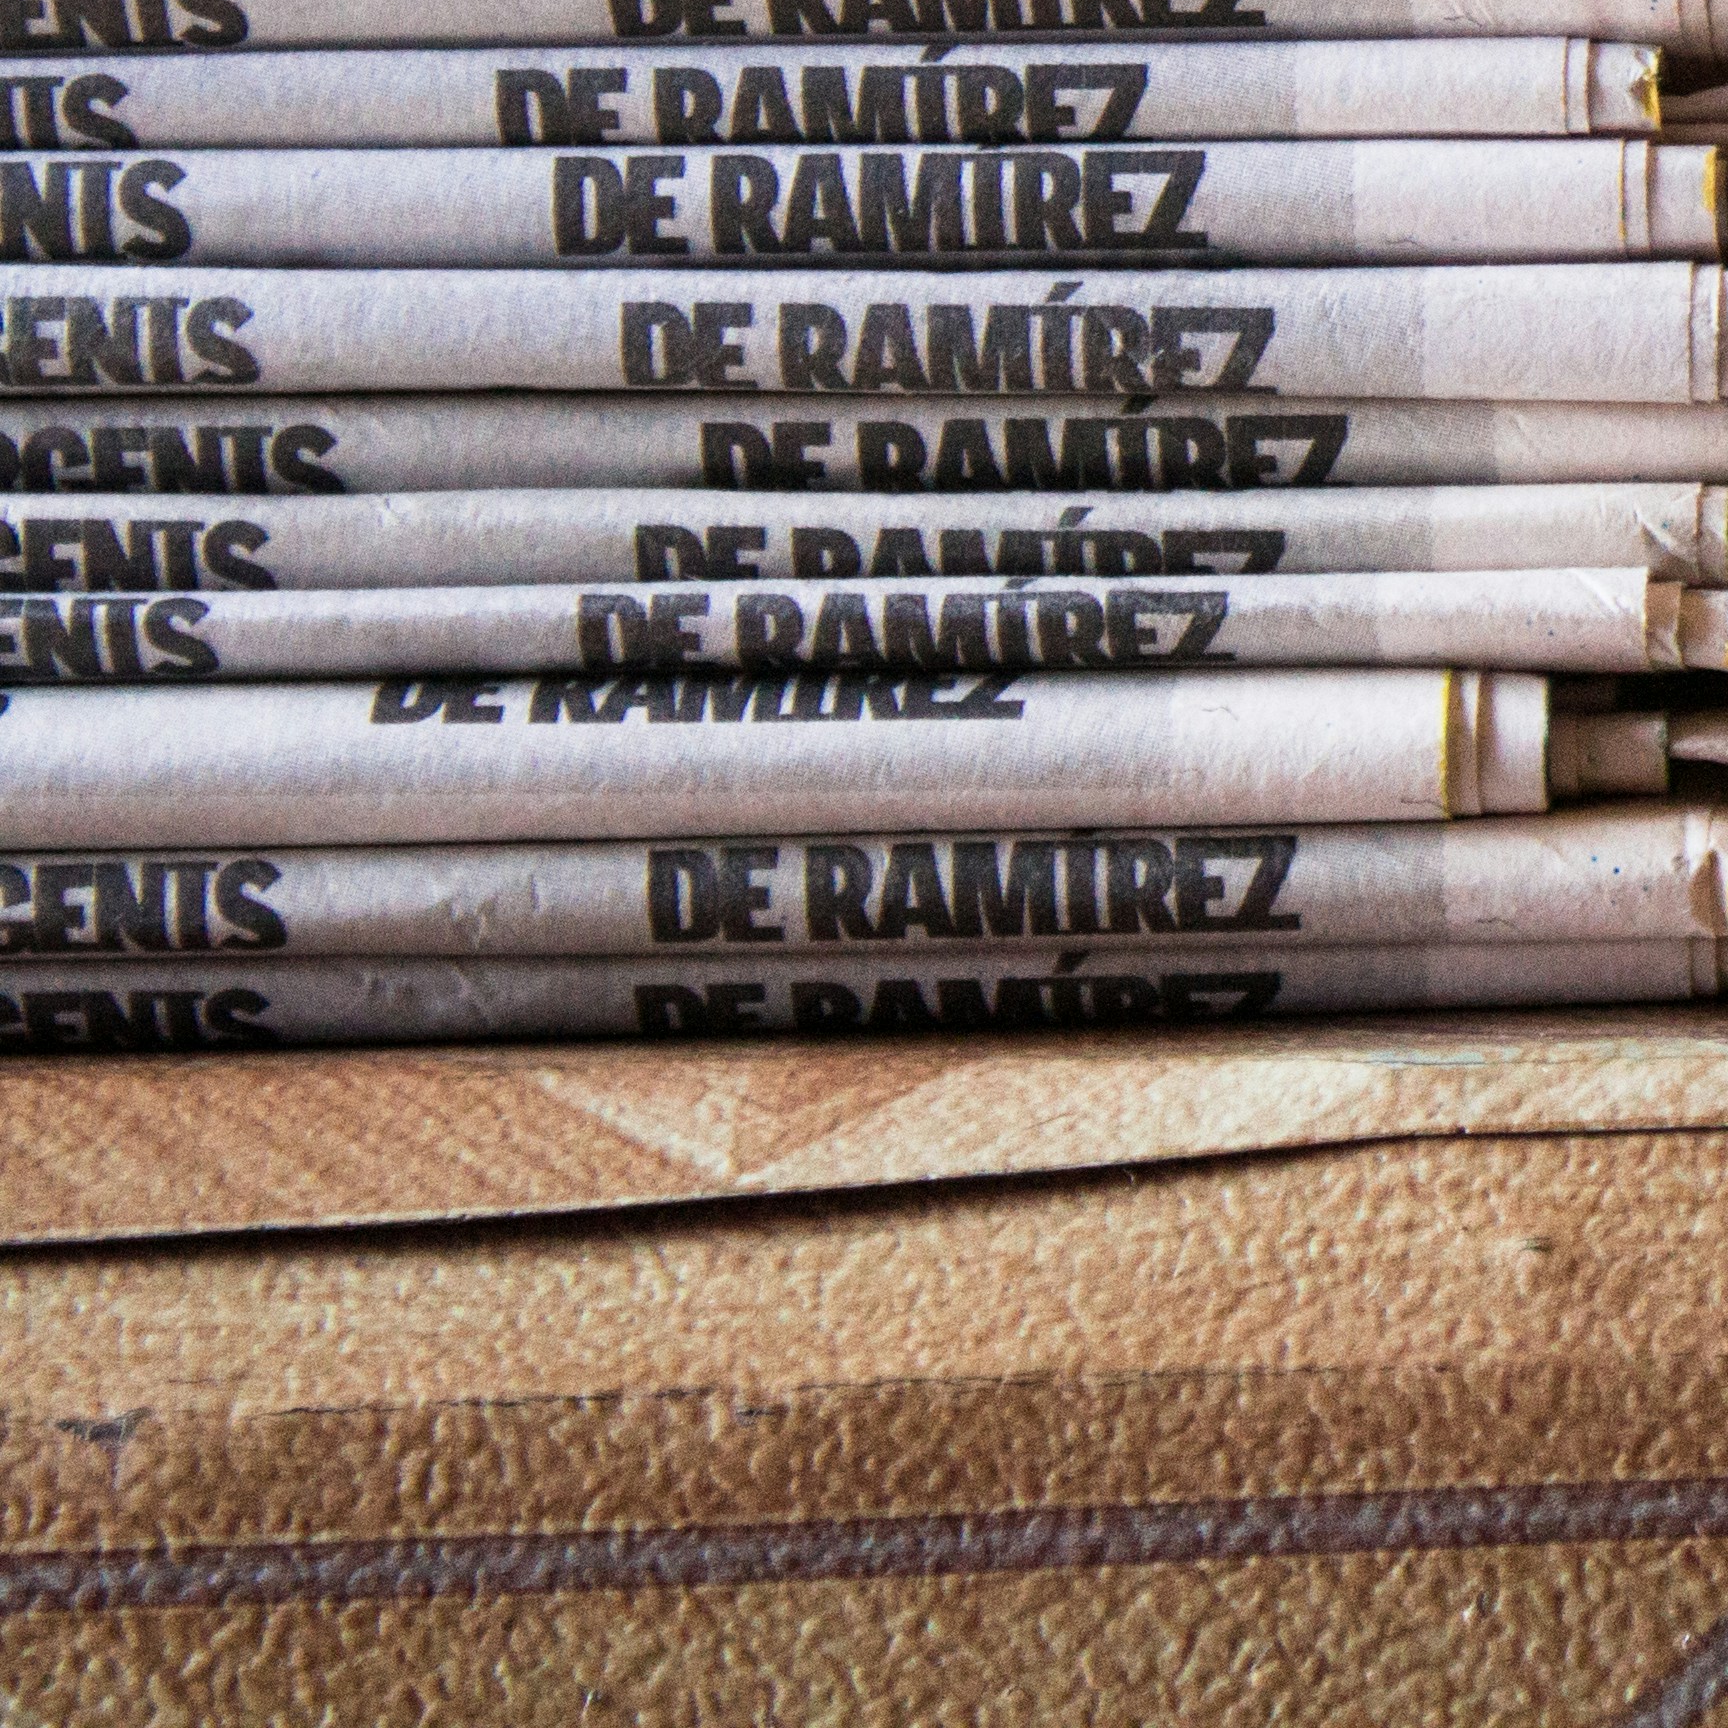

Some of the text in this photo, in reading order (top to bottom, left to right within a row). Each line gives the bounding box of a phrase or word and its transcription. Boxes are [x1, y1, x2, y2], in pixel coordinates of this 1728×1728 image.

[496, 44, 1150, 147] DE RAMÍREZ
[551, 154, 689, 256] DE
[619, 280, 1278, 394] DE RAMÍREZ
[577, 592, 710, 666] DE
[648, 845, 787, 943] DE
